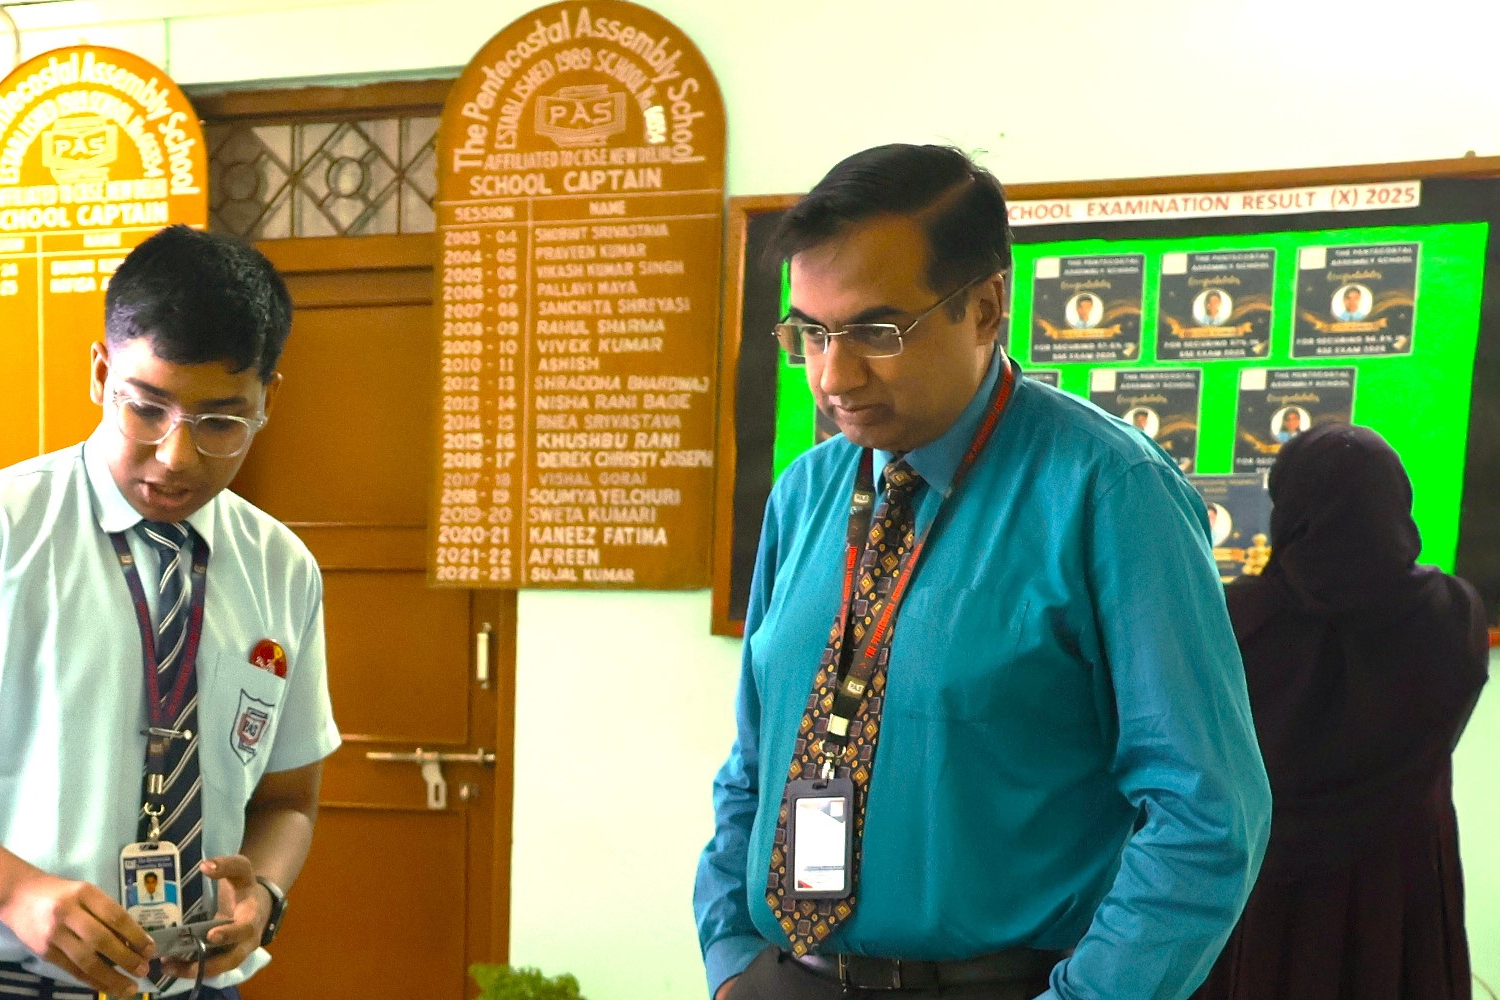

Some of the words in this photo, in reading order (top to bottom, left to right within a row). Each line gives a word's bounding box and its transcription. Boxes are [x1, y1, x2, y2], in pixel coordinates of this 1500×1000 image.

[574, 6, 684, 84] Assembly
[462, 9, 571, 122] Pentecostal
[549, 100, 612, 127] PAS
[667, 77, 706, 164] School
[81, 51, 173, 121] Assembly
[158, 111, 201, 195] School
[56, 137, 105, 156] PAS
[453, 124, 488, 173] The
[469, 173, 551, 196] SCHOOL
[563, 168, 663, 192] CAPTAIN
[454, 206, 515, 221] SESSION
[589, 200, 626, 216] NAME
[1008, 202, 1073, 220] CHOOL
[1087, 191, 1231, 217] EXAMINATION
[1242, 192, 1315, 210] RESULT
[1330, 188, 1358, 210] (X)
[1365, 187, 1416, 204] 2025
[77, 202, 170, 226] CAPTAIN
[443, 249, 483, 265] 2004
[497, 283, 518, 298] 07
[536, 319, 590, 335] RAHUL
[597, 318, 666, 334] SHARMA
[499, 339, 518, 355] 10
[537, 338, 591, 353] VIVEK
[598, 337, 663, 353] KUMAR
[441, 357, 482, 373] 2010
[499, 357, 514, 372] 11
[538, 356, 599, 372] ASHISH
[443, 414, 481, 430] 2014
[496, 432, 517, 449] 16
[536, 432, 628, 449] KHUSHBU
[634, 432, 681, 449] RANI
[495, 452, 516, 469] 17
[528, 506, 585, 523] SWETA
[588, 505, 657, 523] KUMARI
[529, 526, 596, 545] KANEEZ
[603, 527, 668, 546] FATIMA
[528, 548, 599, 566] AFREEN
